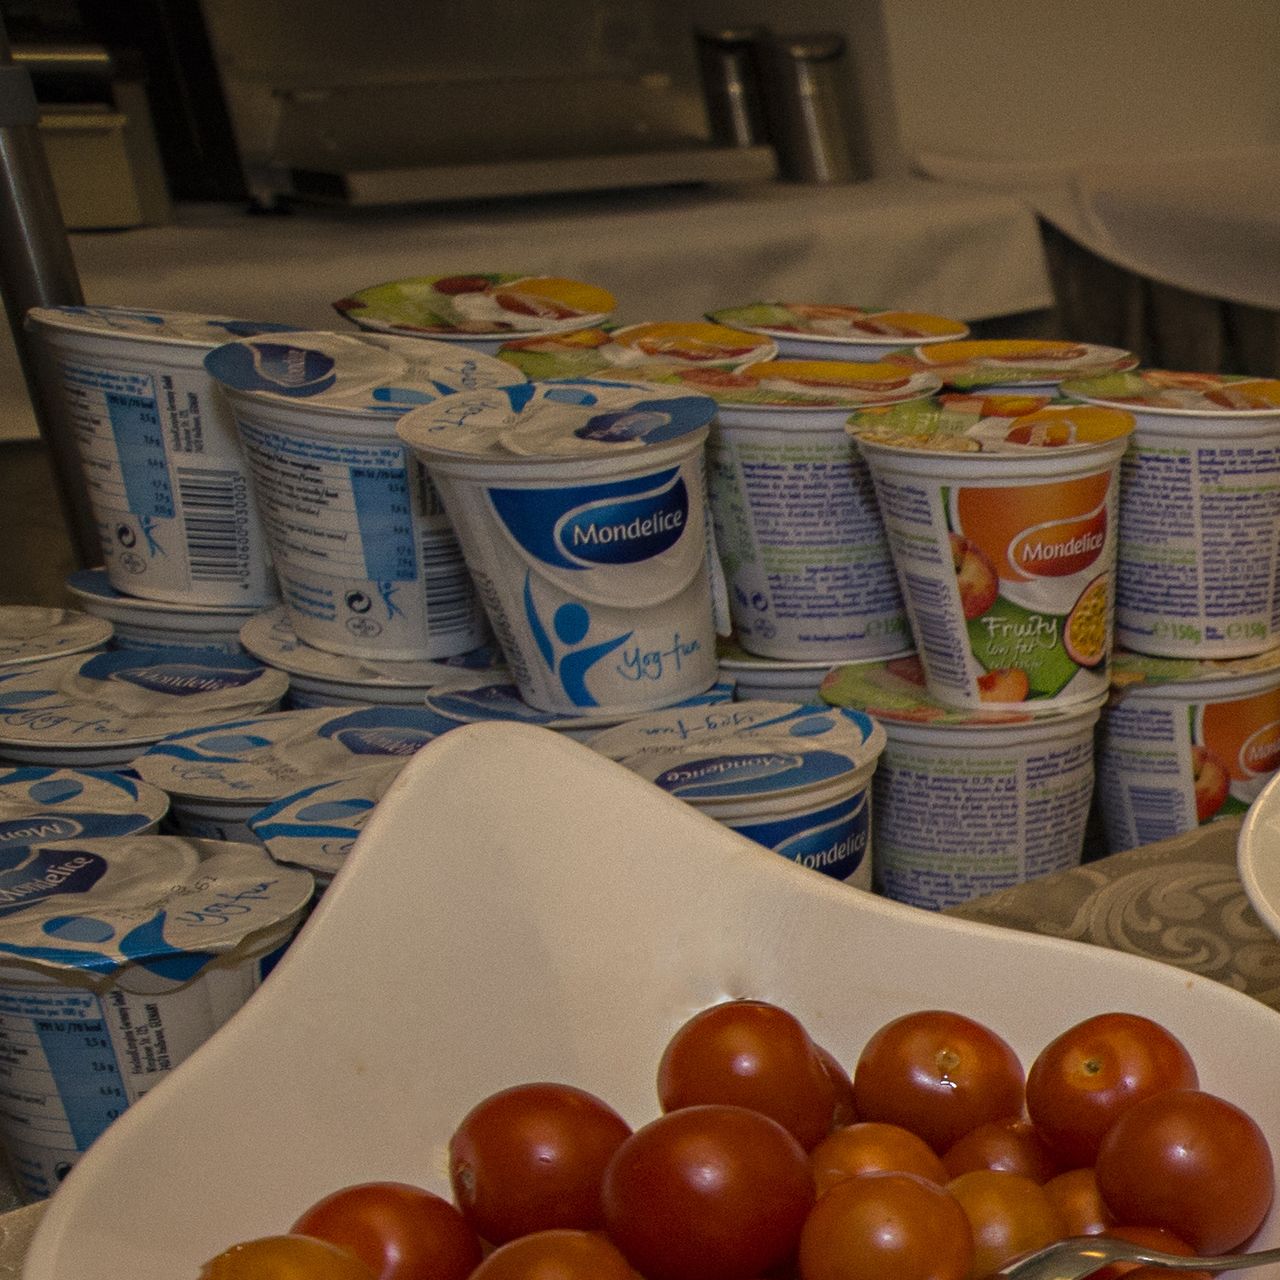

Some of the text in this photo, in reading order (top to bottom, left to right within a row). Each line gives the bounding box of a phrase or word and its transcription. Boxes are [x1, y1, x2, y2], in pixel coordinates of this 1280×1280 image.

[573, 509, 683, 546] Mondelice
[1022, 533, 1103, 563] Mondelice
[980, 615, 1058, 649] Fruity
[667, 754, 785, 782] Mondelice
